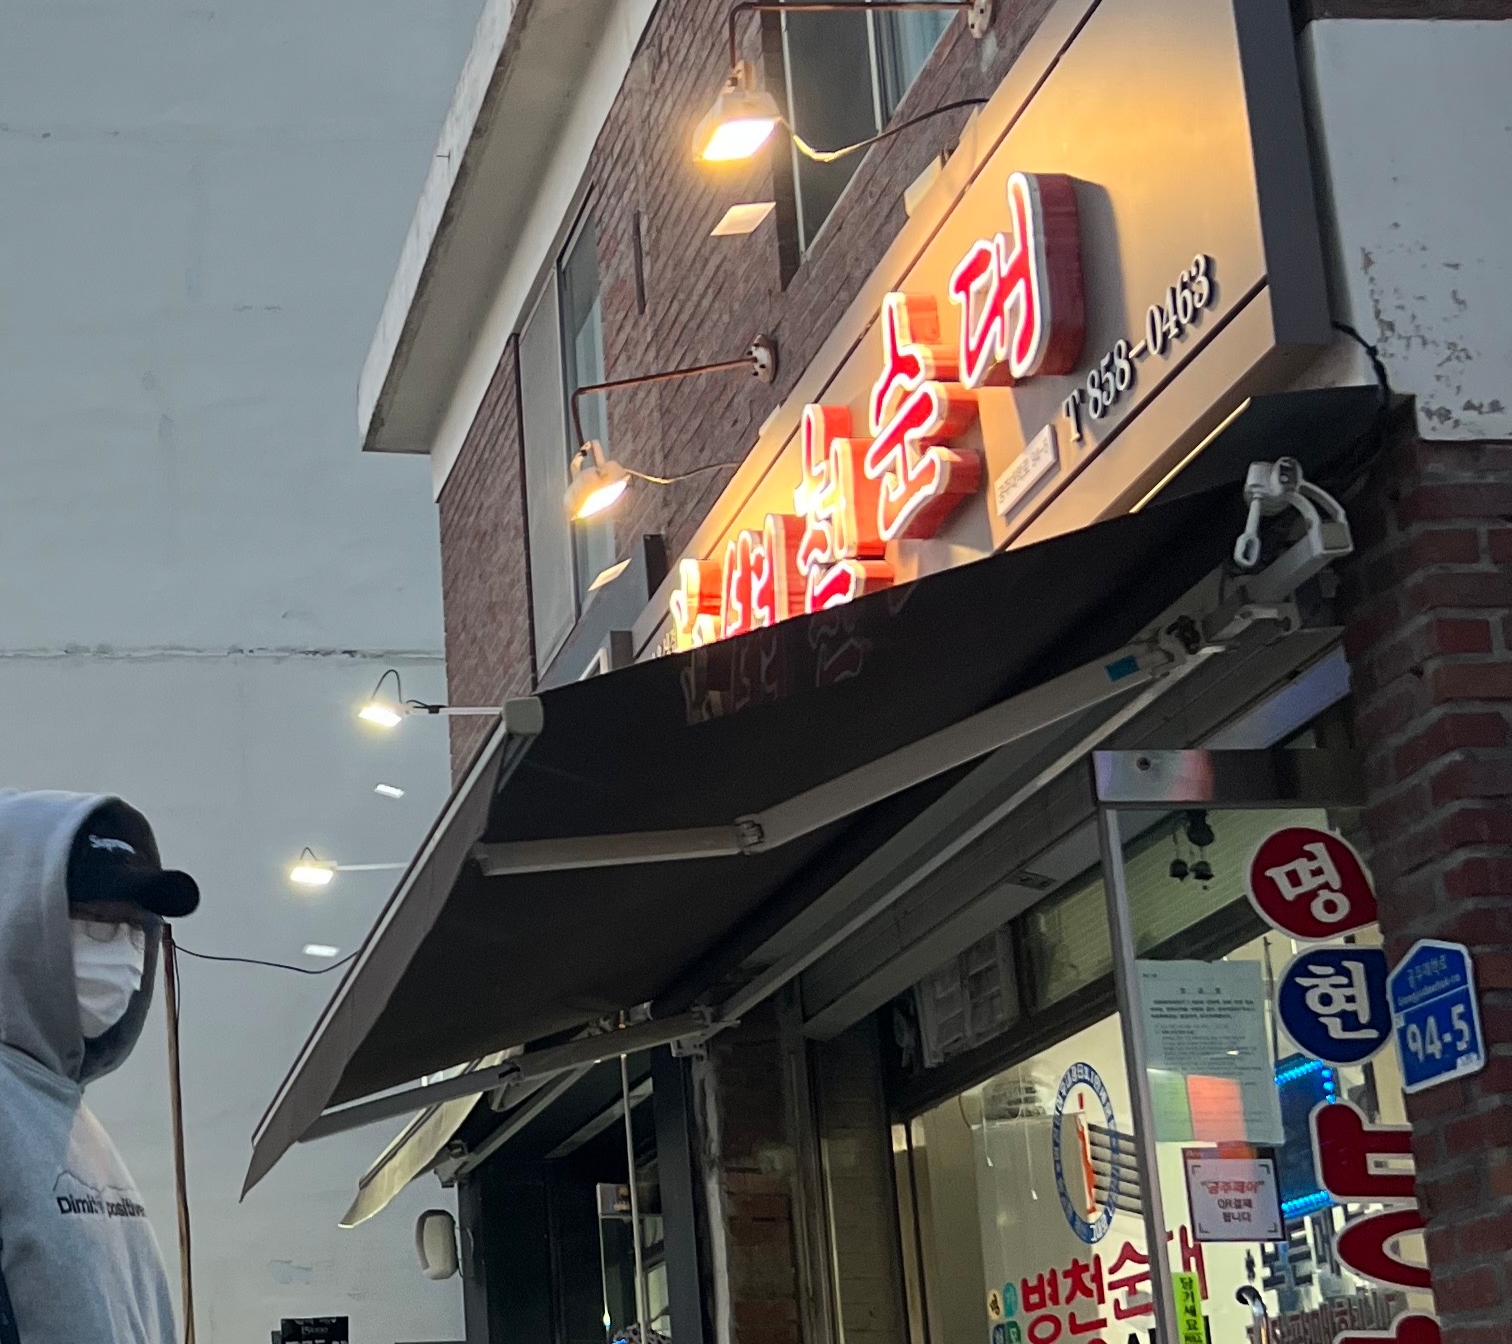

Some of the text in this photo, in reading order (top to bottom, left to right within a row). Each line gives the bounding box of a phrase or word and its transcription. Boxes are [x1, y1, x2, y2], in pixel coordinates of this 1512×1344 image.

[1061, 253, 1215, 443] T 858-0463
[1265, 842, 1352, 923] 명
[1294, 960, 1379, 1041] 현
[1406, 1003, 1471, 1064] 94-5
[1179, 1276, 1198, 1331] 당기세요
